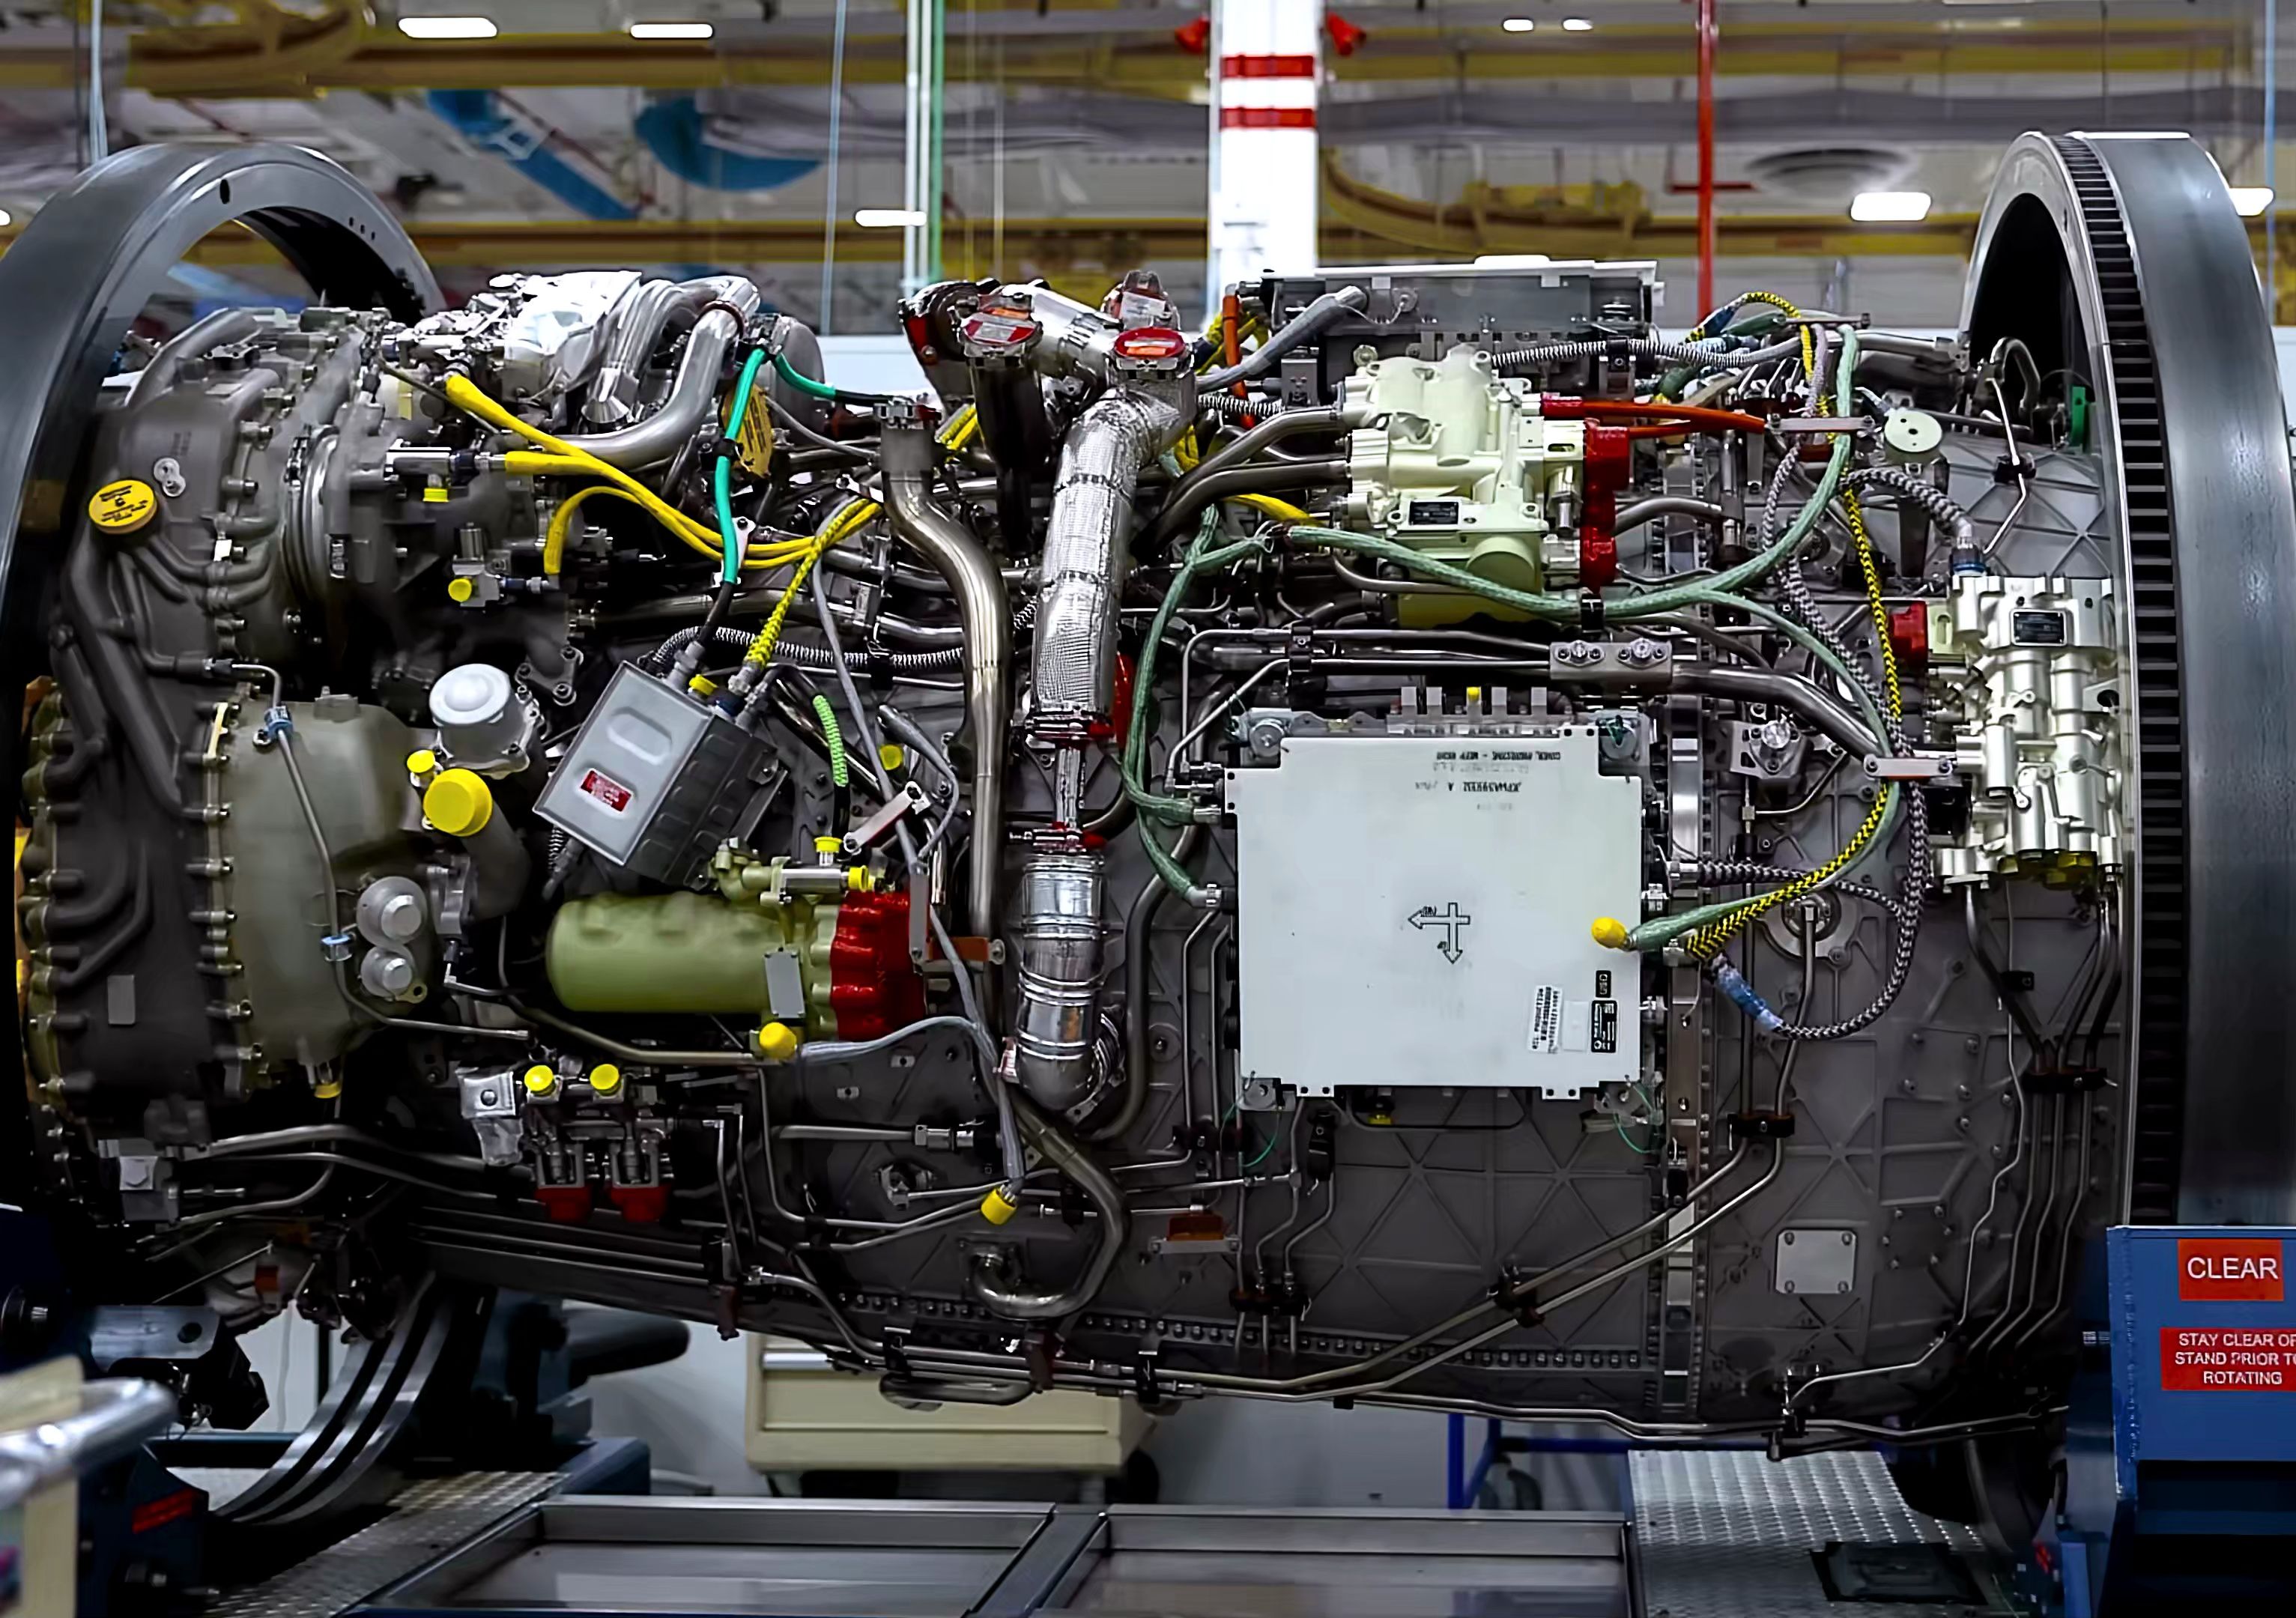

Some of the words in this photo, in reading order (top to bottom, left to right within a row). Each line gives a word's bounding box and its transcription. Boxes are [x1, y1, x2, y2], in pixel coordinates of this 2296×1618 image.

[2187, 1257, 2278, 1279] CLEAR
[2179, 1333, 2218, 1346] STAY
[2223, 1333, 2274, 1347] CLEAR
[2175, 1352, 2226, 1366] STAND
[2231, 1353, 2280, 1366] PRIOR
[2283, 1353, 2296, 1366] T
[2203, 1372, 2283, 1385] ROTATING
